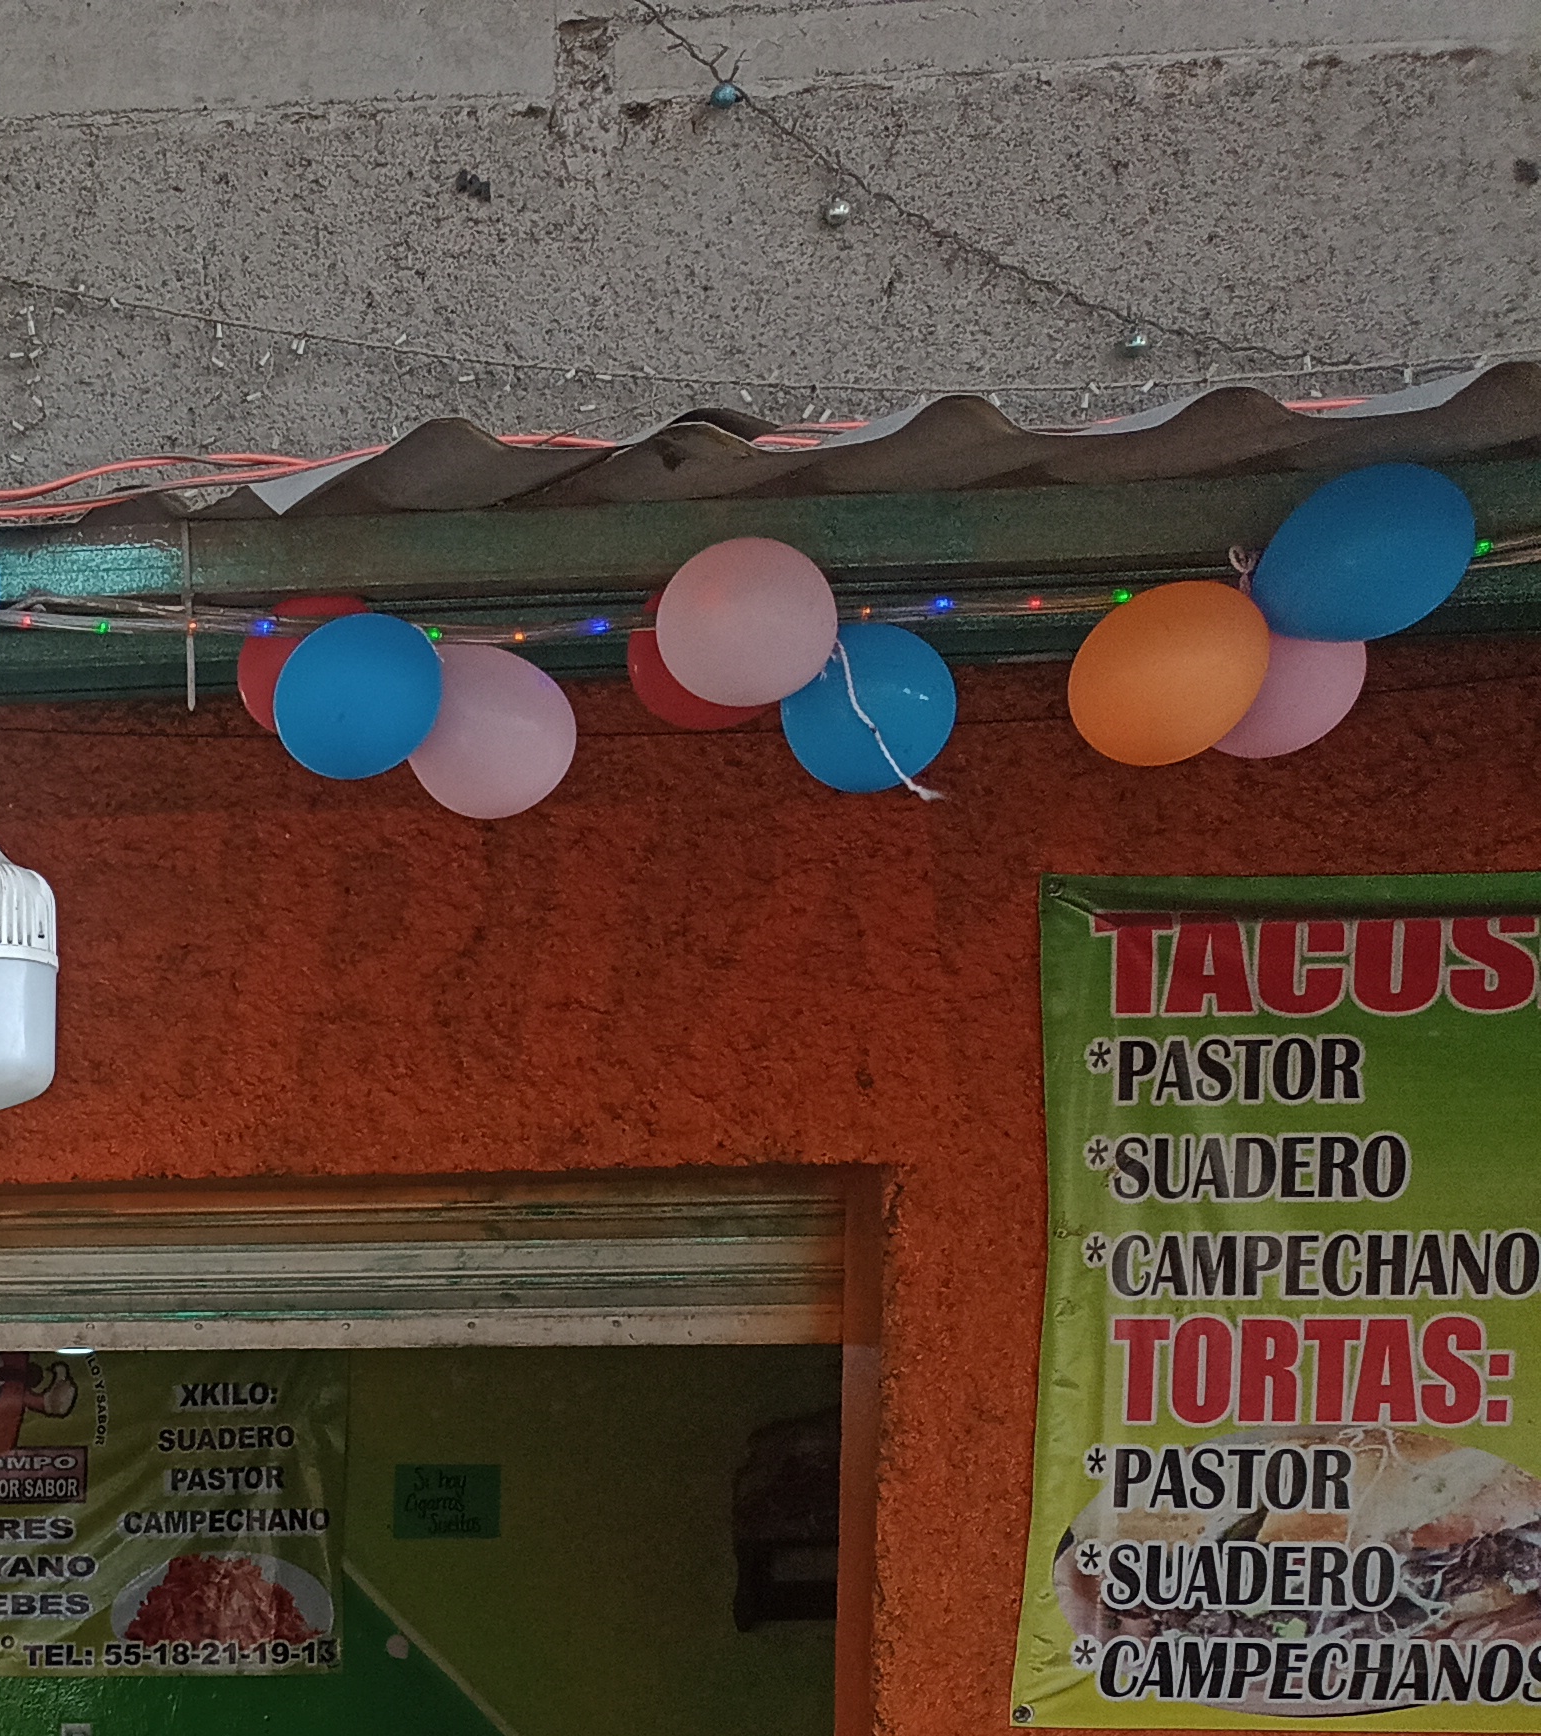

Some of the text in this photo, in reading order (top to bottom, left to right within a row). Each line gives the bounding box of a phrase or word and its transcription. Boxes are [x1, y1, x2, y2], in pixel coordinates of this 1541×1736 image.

[1090, 912, 1535, 1016] TACOS
[1114, 1316, 1512, 1424] TORTAS:
[179, 1381, 278, 1407] XKILO:
[95, 1393, 108, 1445] SABOR
[158, 1425, 294, 1452] SUADERO
[24, 1478, 78, 1497] SABOR
[171, 1465, 284, 1492] PASTOR
[124, 1507, 330, 1535] CAMPECHANO
[25, 1643, 93, 1667] TEL:
